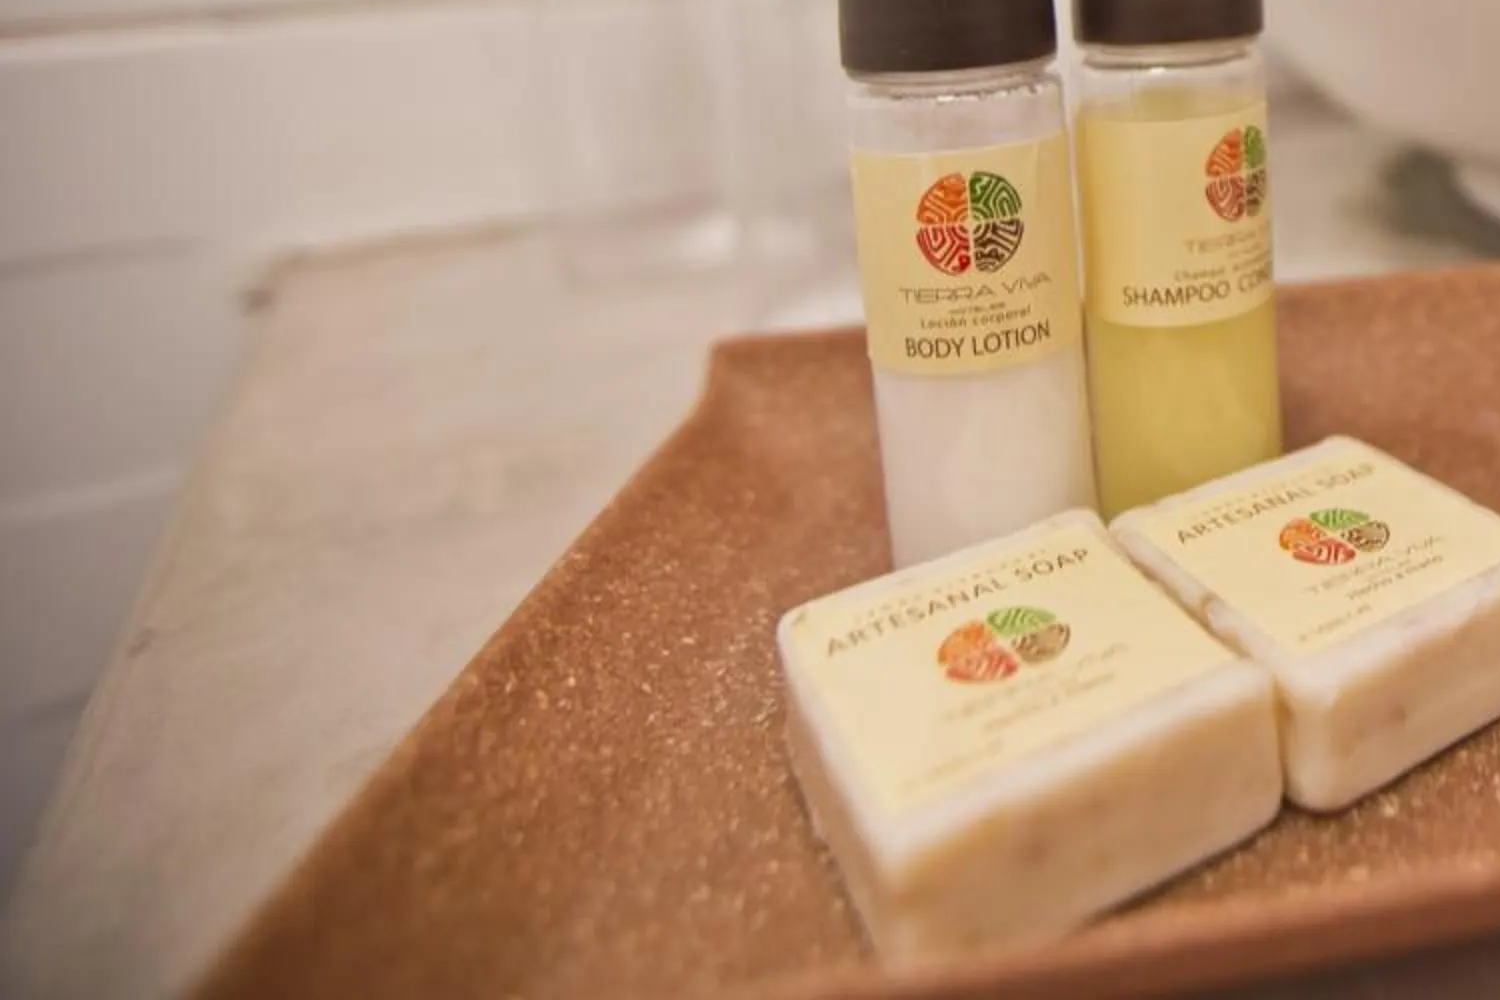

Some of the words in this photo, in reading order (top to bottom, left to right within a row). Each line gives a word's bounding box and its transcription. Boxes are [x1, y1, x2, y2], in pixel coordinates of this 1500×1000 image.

[1122, 280, 1231, 308] SHAMPOO
[904, 336, 966, 359] BODY
[971, 318, 1052, 357] LOTION
[1177, 486, 1318, 545] ARTESANAL
[826, 577, 1008, 658] ARTESANAL
[1014, 547, 1089, 582] SOAP
